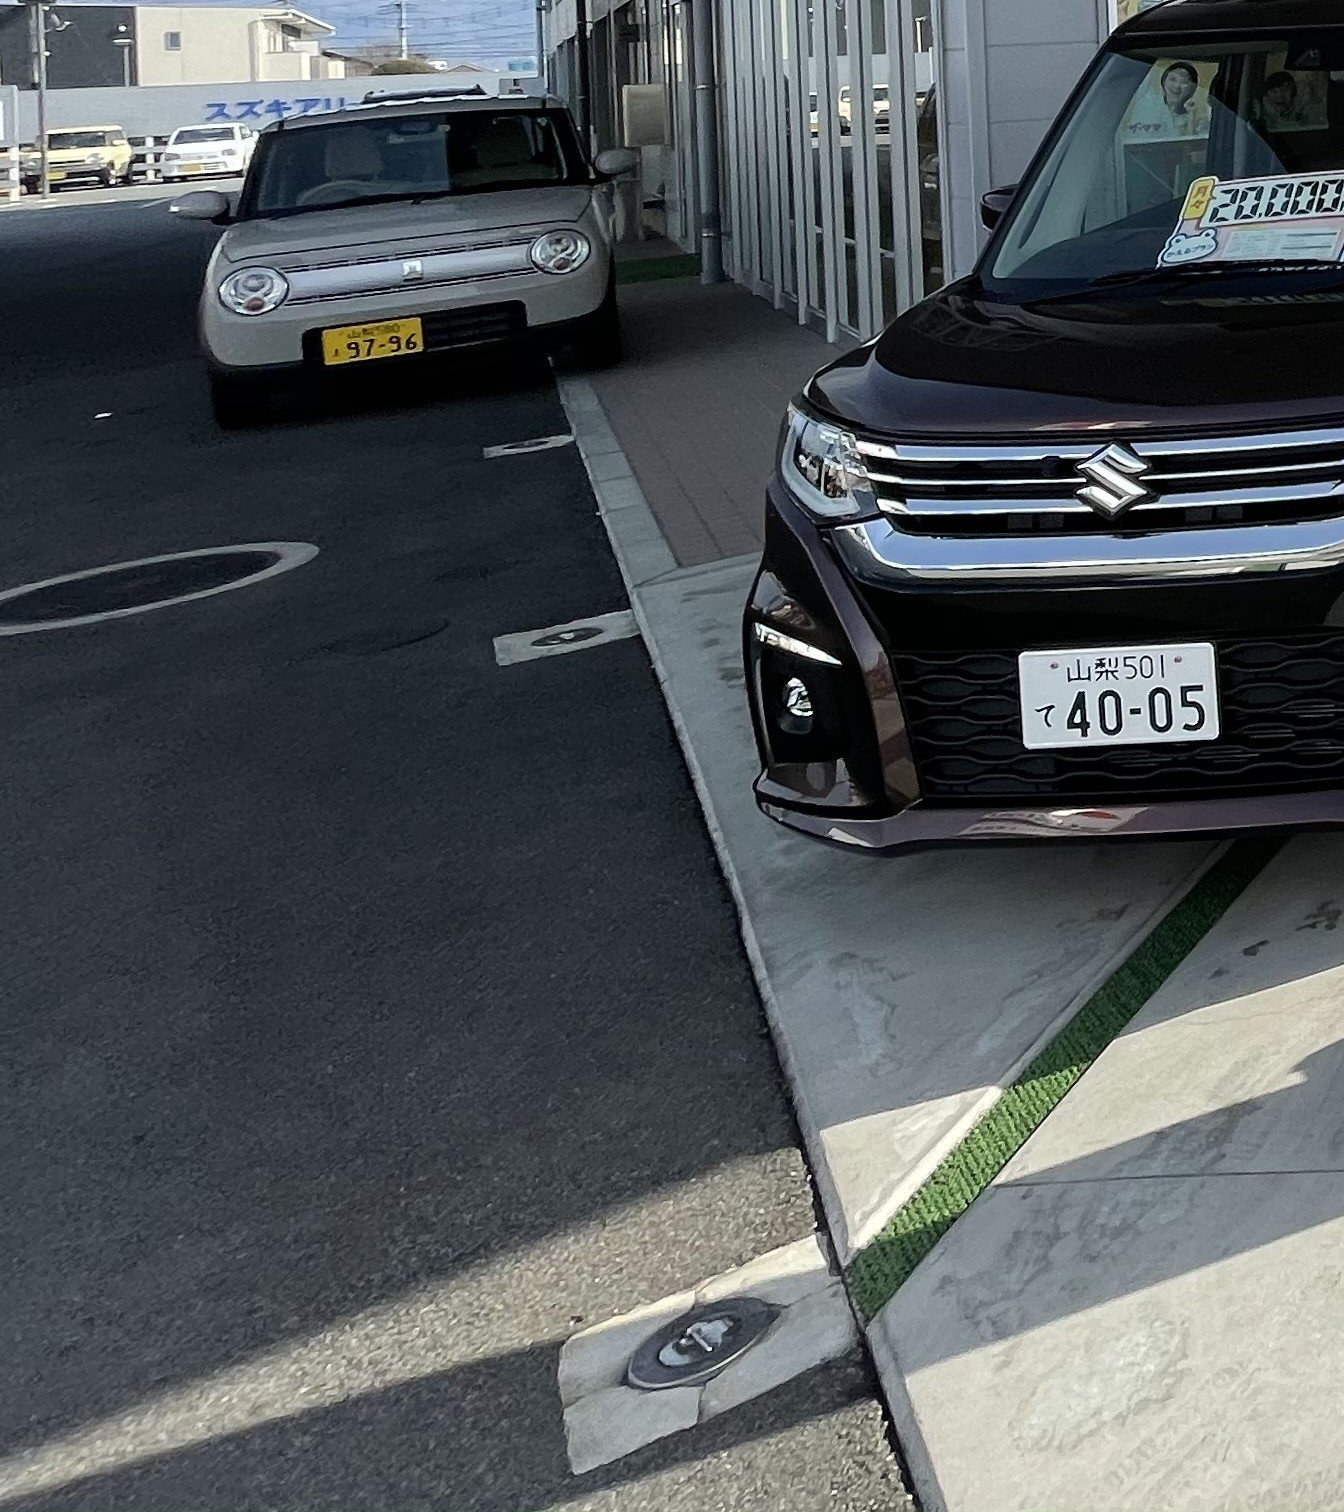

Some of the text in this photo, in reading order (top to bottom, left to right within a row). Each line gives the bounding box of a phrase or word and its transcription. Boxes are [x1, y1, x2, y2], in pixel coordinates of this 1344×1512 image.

[346, 332, 418, 359] 97-96
[1067, 654, 1166, 682] 山梨501
[1067, 684, 1206, 738] 40-05
